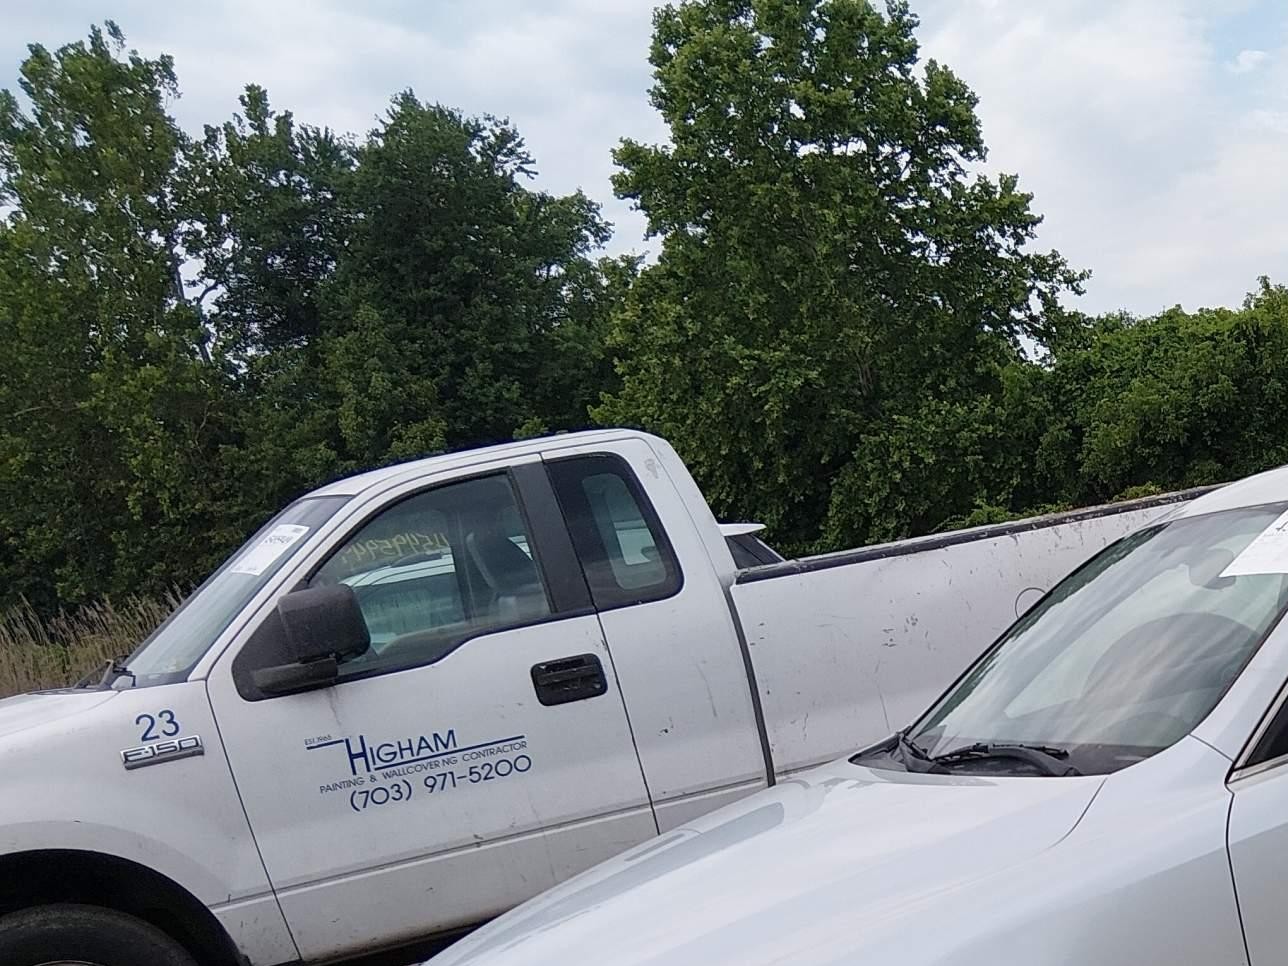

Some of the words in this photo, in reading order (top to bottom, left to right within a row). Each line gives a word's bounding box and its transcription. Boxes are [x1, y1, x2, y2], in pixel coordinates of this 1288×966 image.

[135, 709, 180, 742] 23
[121, 734, 202, 766] F-150
[319, 776, 366, 794] PAINTING
[369, 774, 377, 783] &
[462, 740, 527, 762] CONTRACTOR
[350, 779, 412, 812] (703)
[424, 755, 532, 793] 971-5200
